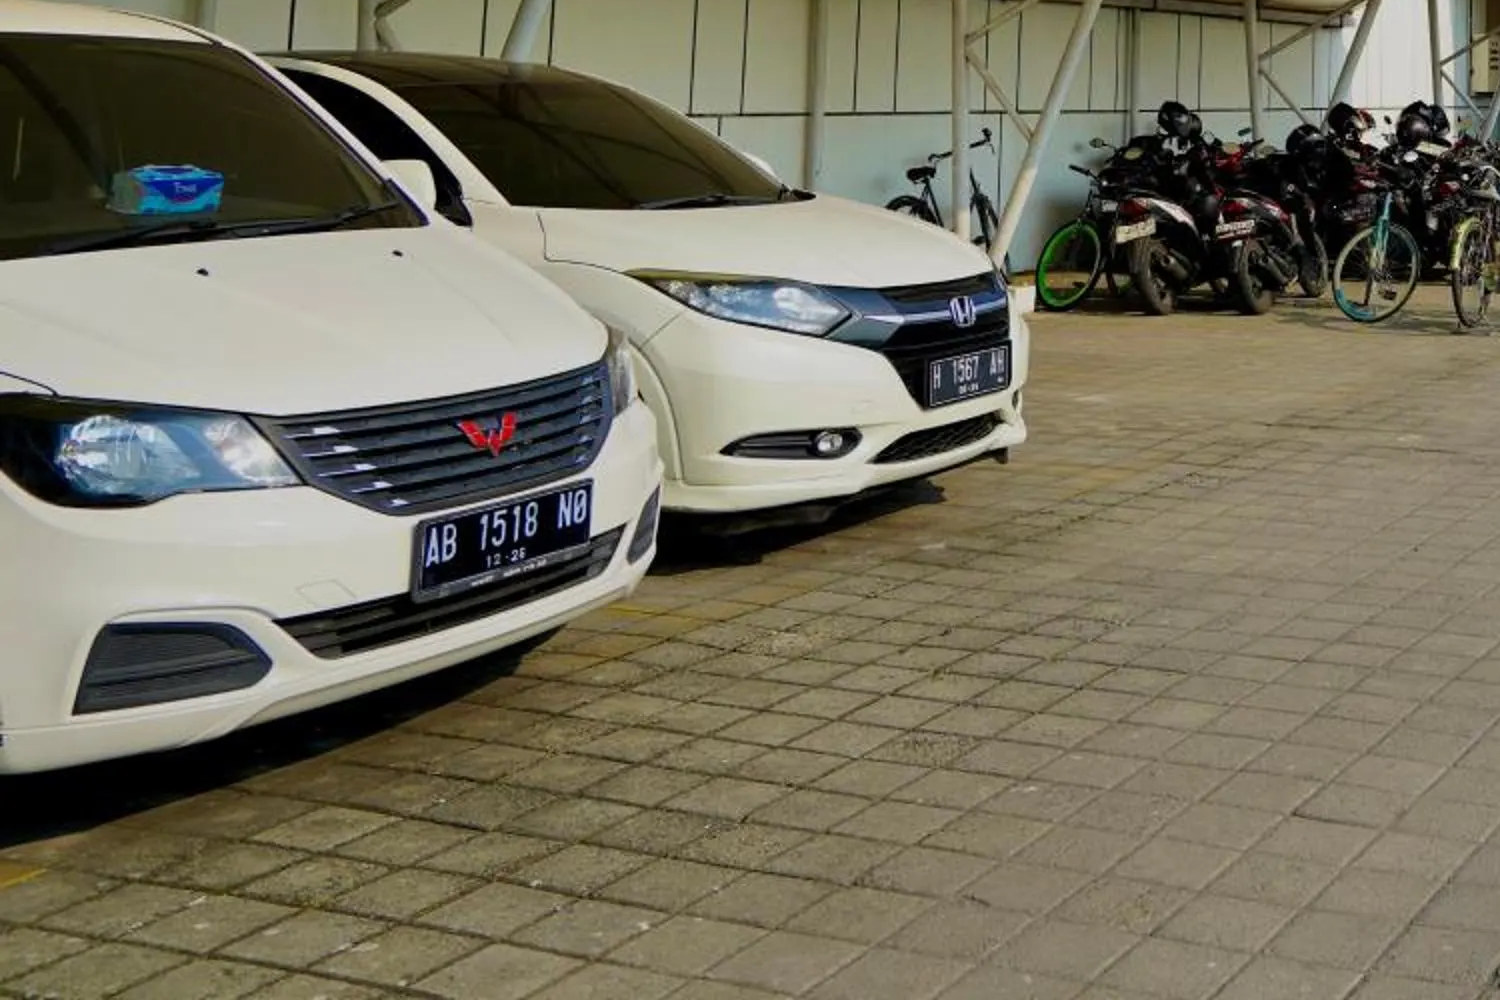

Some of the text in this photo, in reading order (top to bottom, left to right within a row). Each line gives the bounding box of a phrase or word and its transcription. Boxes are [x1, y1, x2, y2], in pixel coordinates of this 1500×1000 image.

[933, 363, 941, 389] H
[952, 354, 980, 386] 1567
[425, 524, 457, 568] AB
[480, 502, 539, 550] 1518
